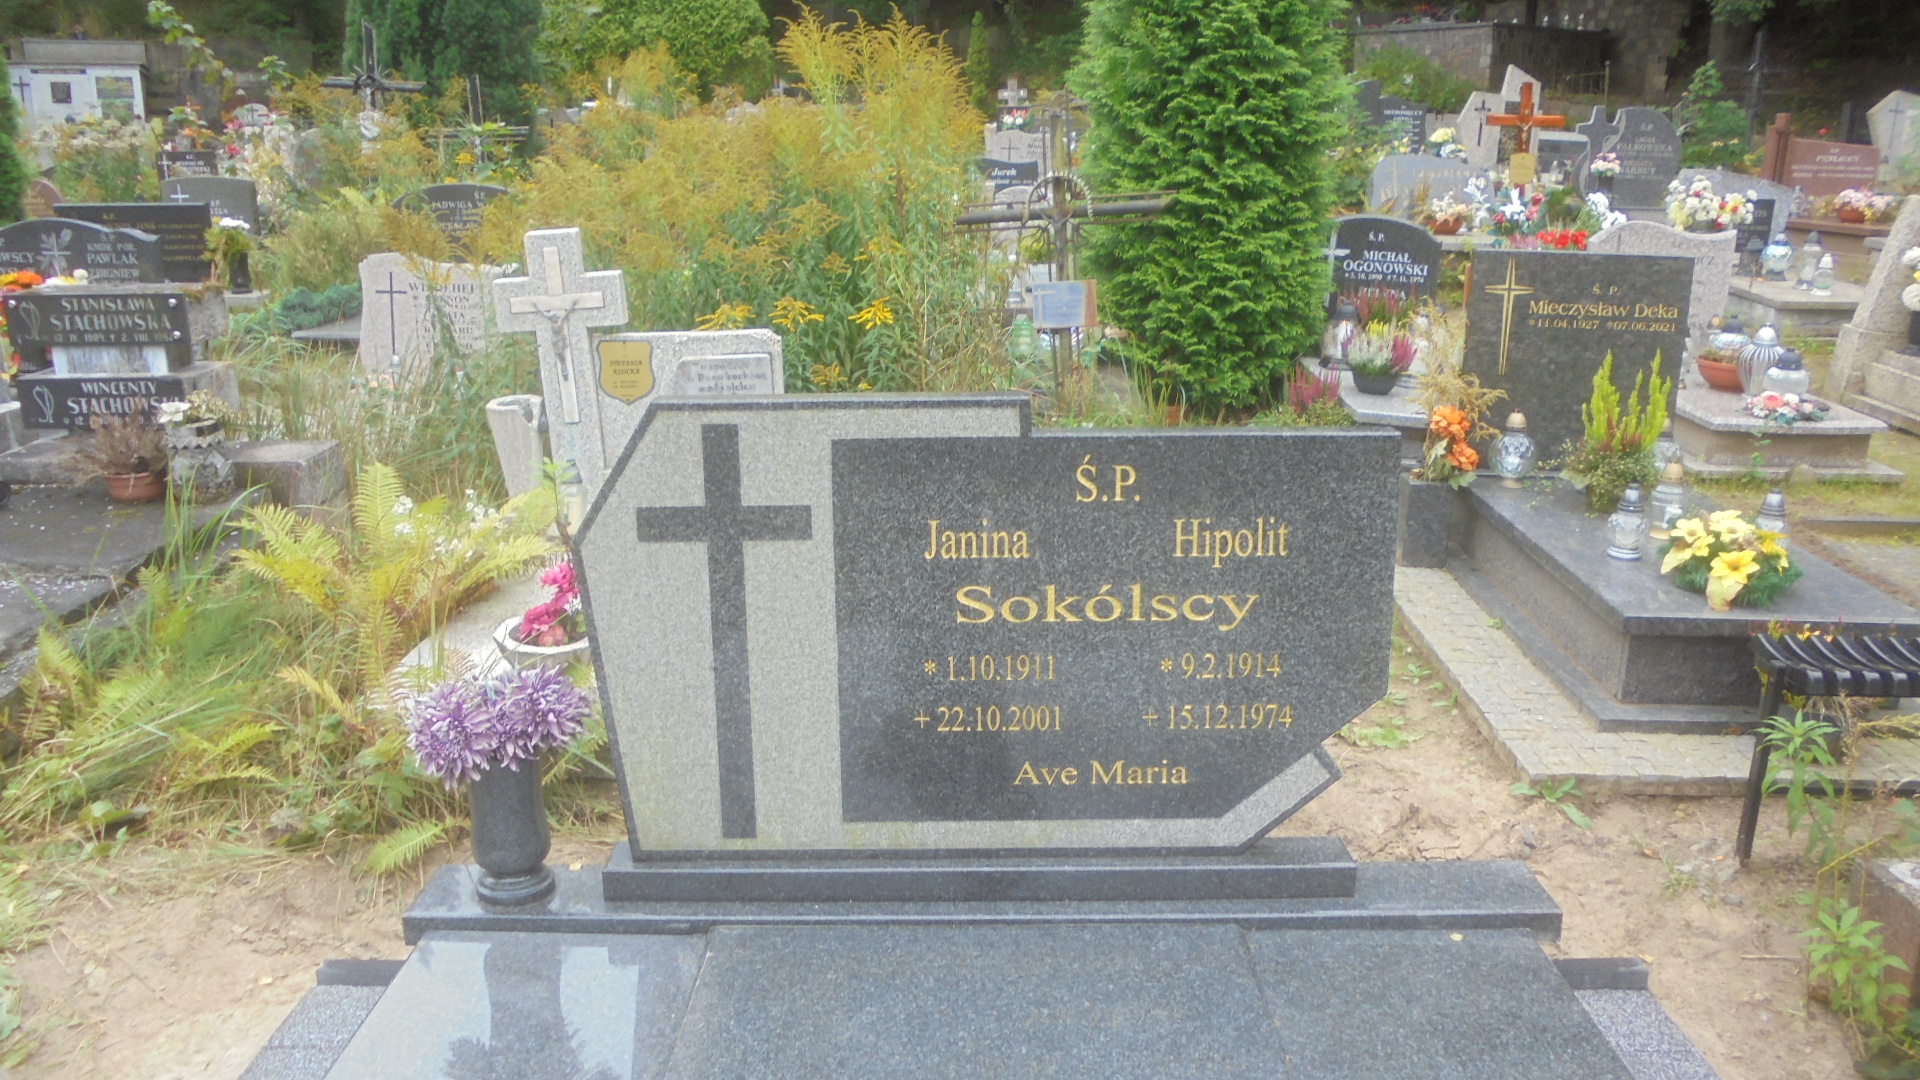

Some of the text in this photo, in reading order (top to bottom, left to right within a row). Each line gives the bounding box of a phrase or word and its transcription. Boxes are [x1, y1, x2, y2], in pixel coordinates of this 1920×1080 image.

[86, 253, 139, 265] PAWLAK
[1362, 250, 1412, 263] MICHAŁ
[1343, 259, 1429, 276] OGONOWSKI
[61, 297, 155, 312] STANISŁAWA
[1528, 299, 1679, 319] Mieczysław Deka
[50, 313, 172, 331] STACHOWSKA
[81, 381, 157, 395] WINCENTY
[1075, 454, 1142, 502] Ś.P.
[924, 516, 1289, 568] Janina Hipolit
[955, 583, 1260, 631] Sokólscy
[947, 652, 1281, 681] 1.10.1911 9.2.1914
[936, 704, 1293, 732] 22.10.2001 15.12.1974
[1012, 760, 1189, 785] Ave Maria
